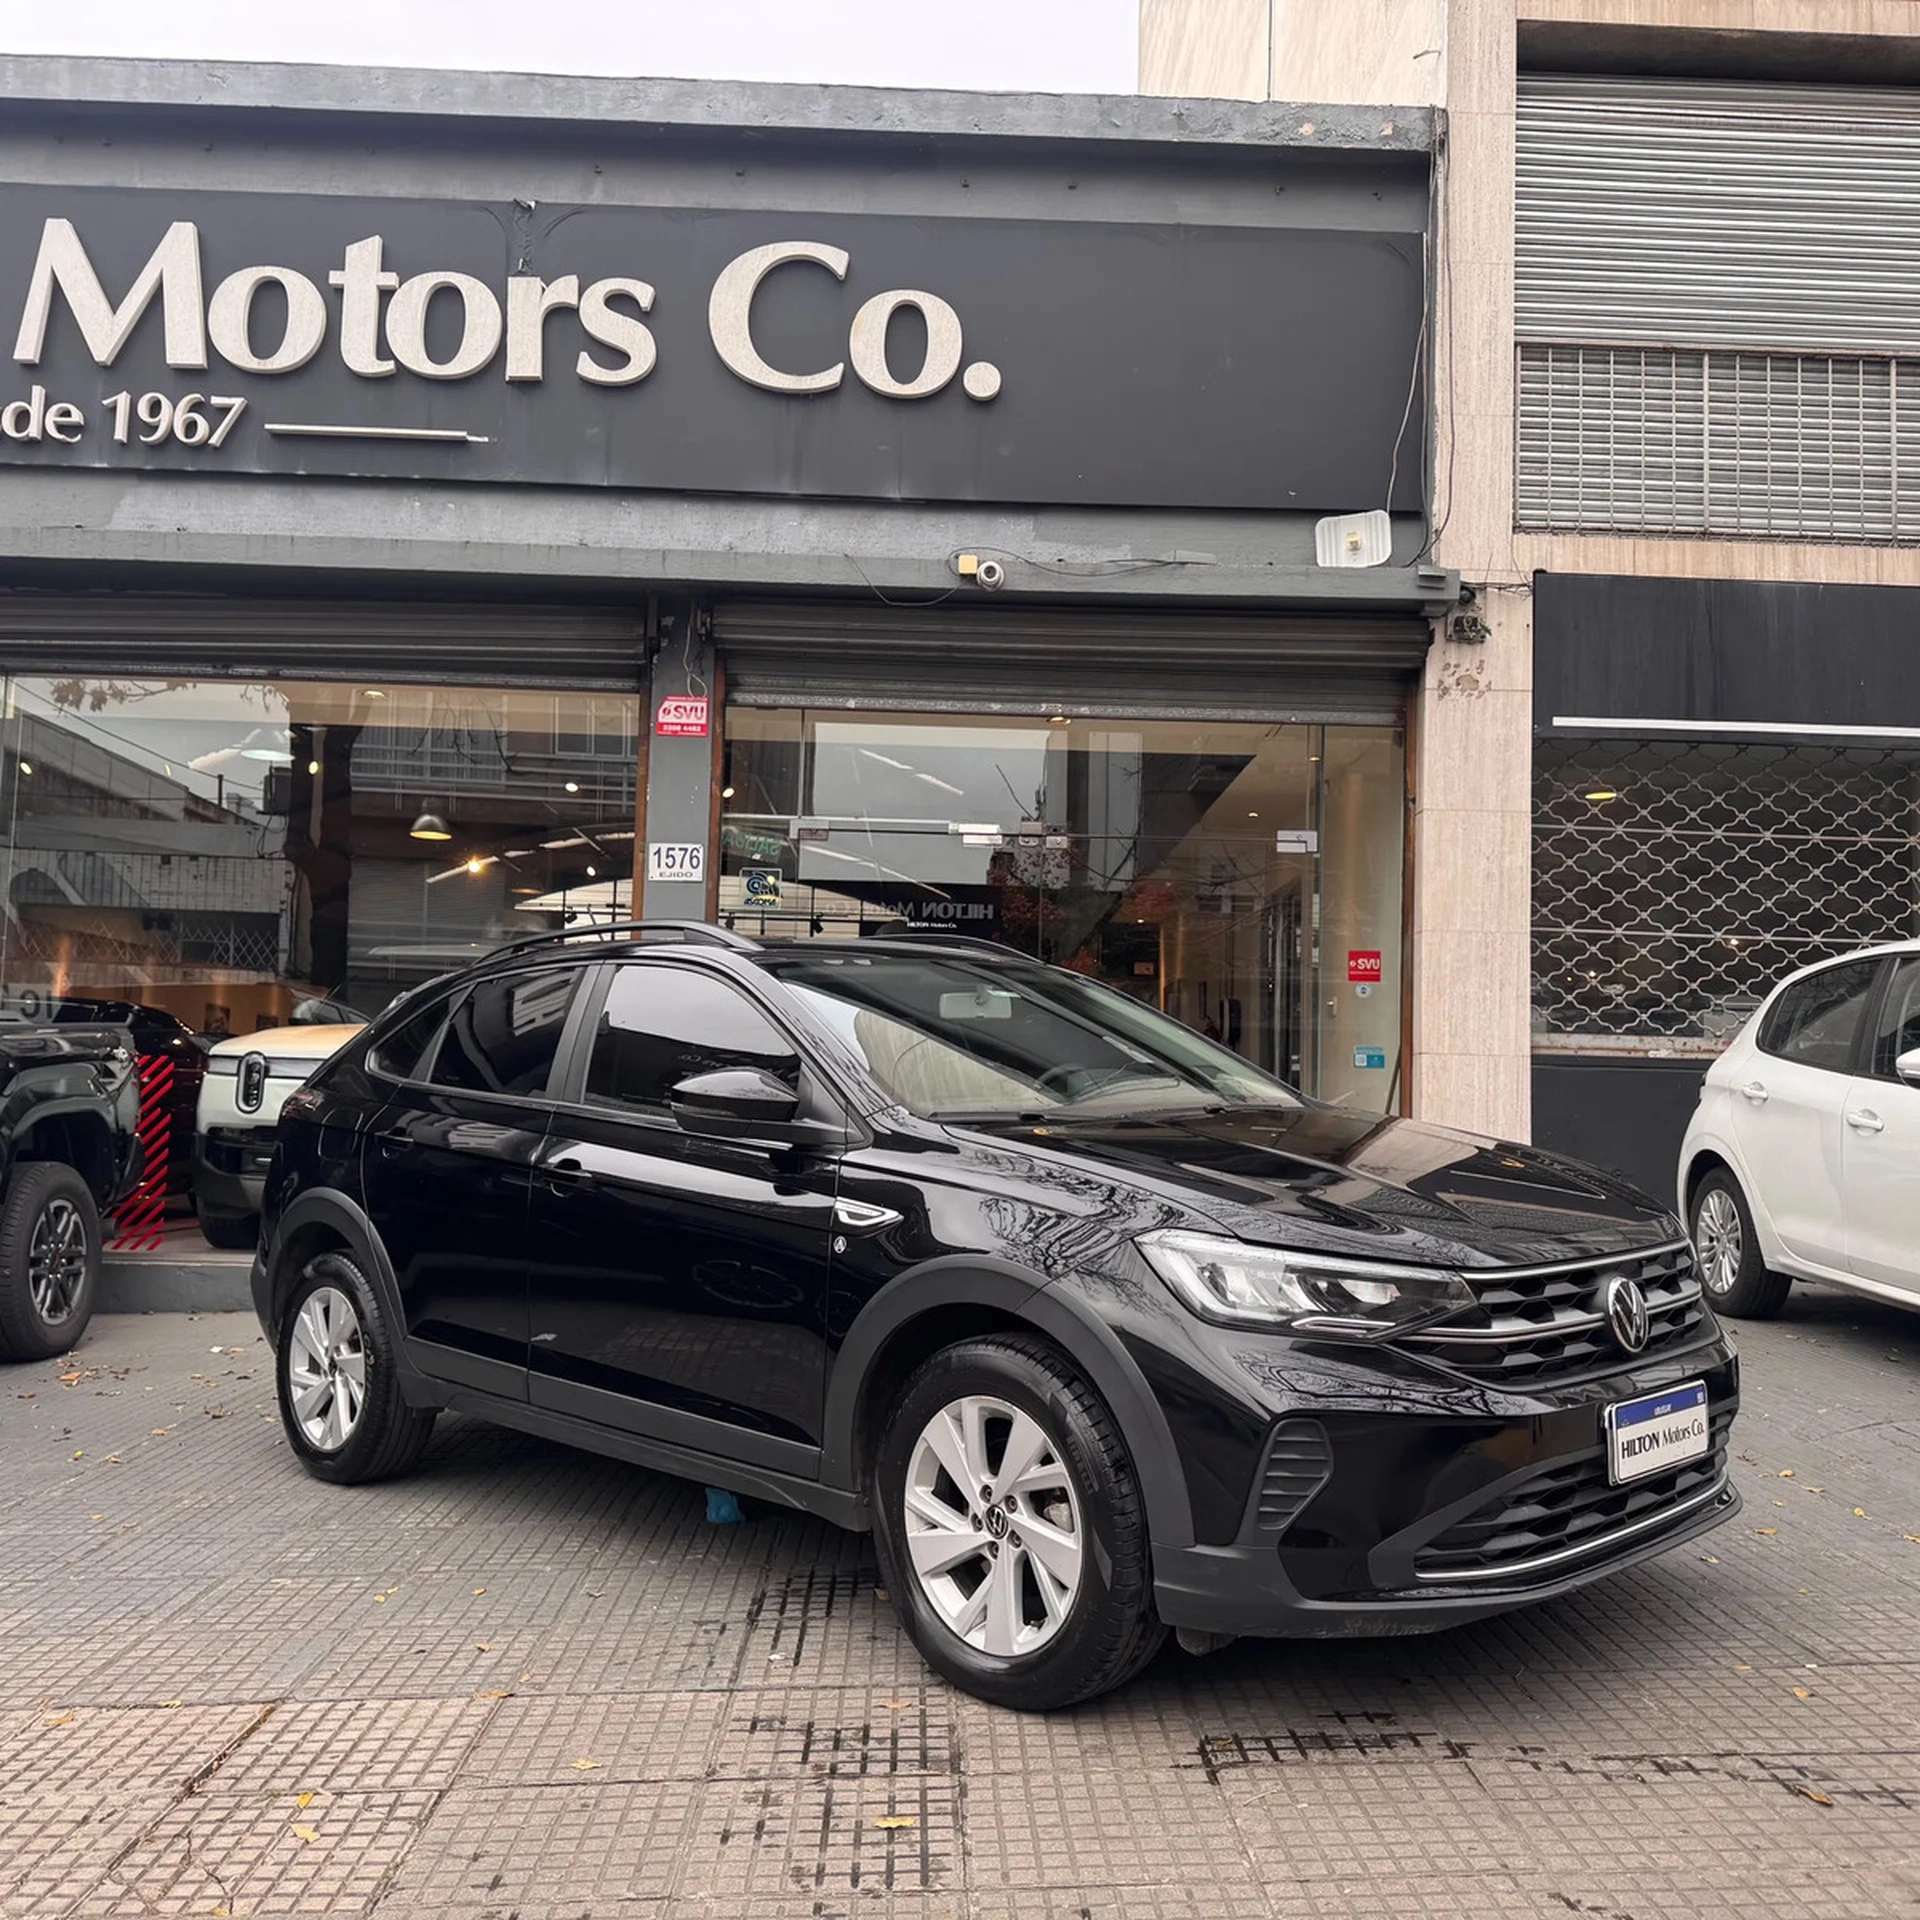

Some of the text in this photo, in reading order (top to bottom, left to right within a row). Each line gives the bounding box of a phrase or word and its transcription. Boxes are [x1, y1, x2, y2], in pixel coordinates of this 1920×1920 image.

[13, 217, 1002, 402] Motors Co.
[0, 384, 248, 448] de 1967
[673, 705, 705, 721] SVU
[653, 846, 701, 869] 1576
[658, 871, 694, 879] EJIDO
[1357, 958, 1380, 970] SVU
[1621, 1431, 1661, 1460] HILTON
[1661, 1426, 1691, 1448] Motors
